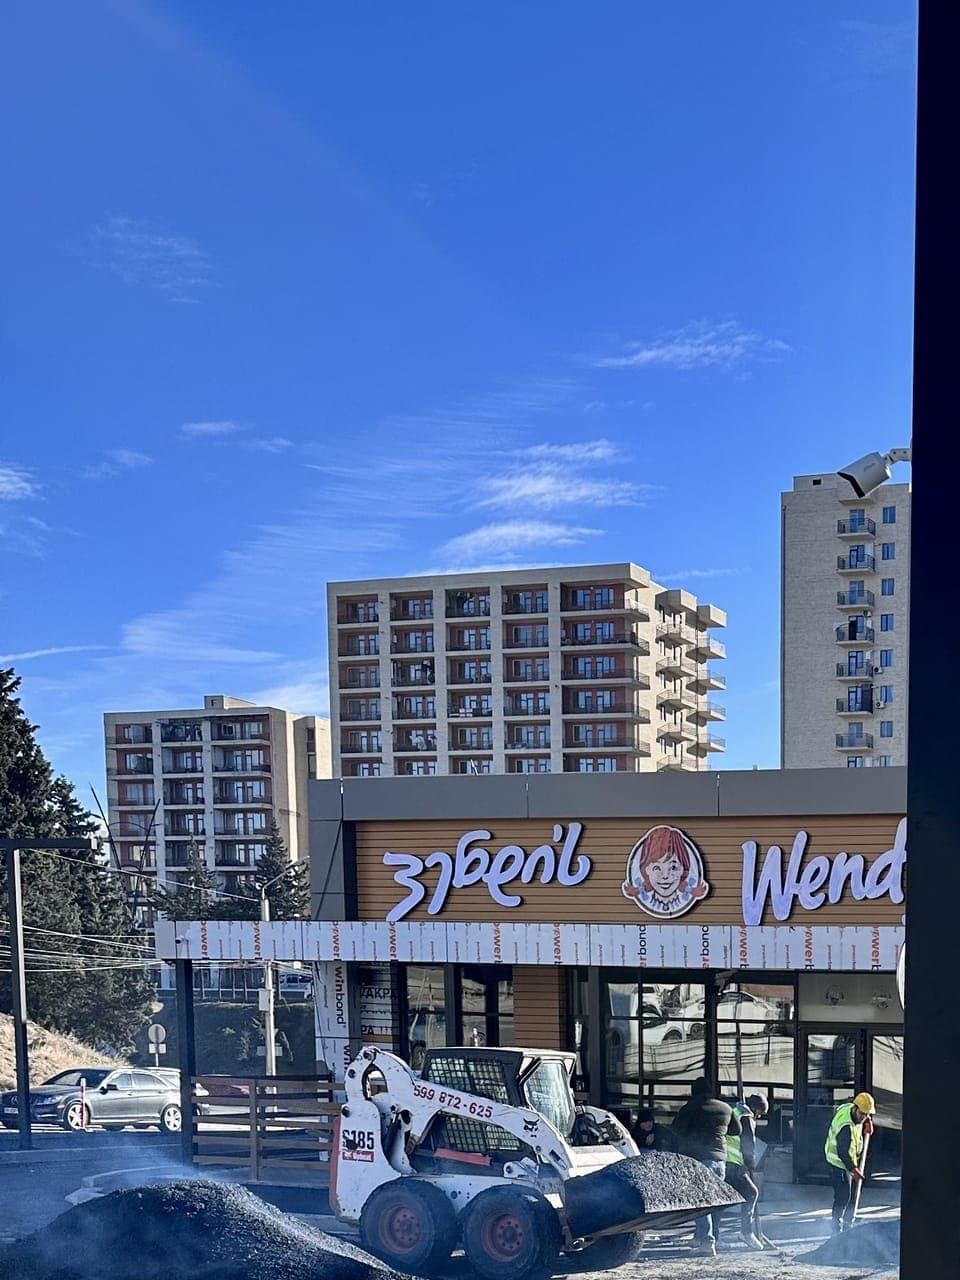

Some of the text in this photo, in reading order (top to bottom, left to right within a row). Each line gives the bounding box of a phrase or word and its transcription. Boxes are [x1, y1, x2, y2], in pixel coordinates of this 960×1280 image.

[742, 816, 906, 925] Wend
[335, 966, 346, 1025] winbond
[413, 1084, 435, 1100] 599
